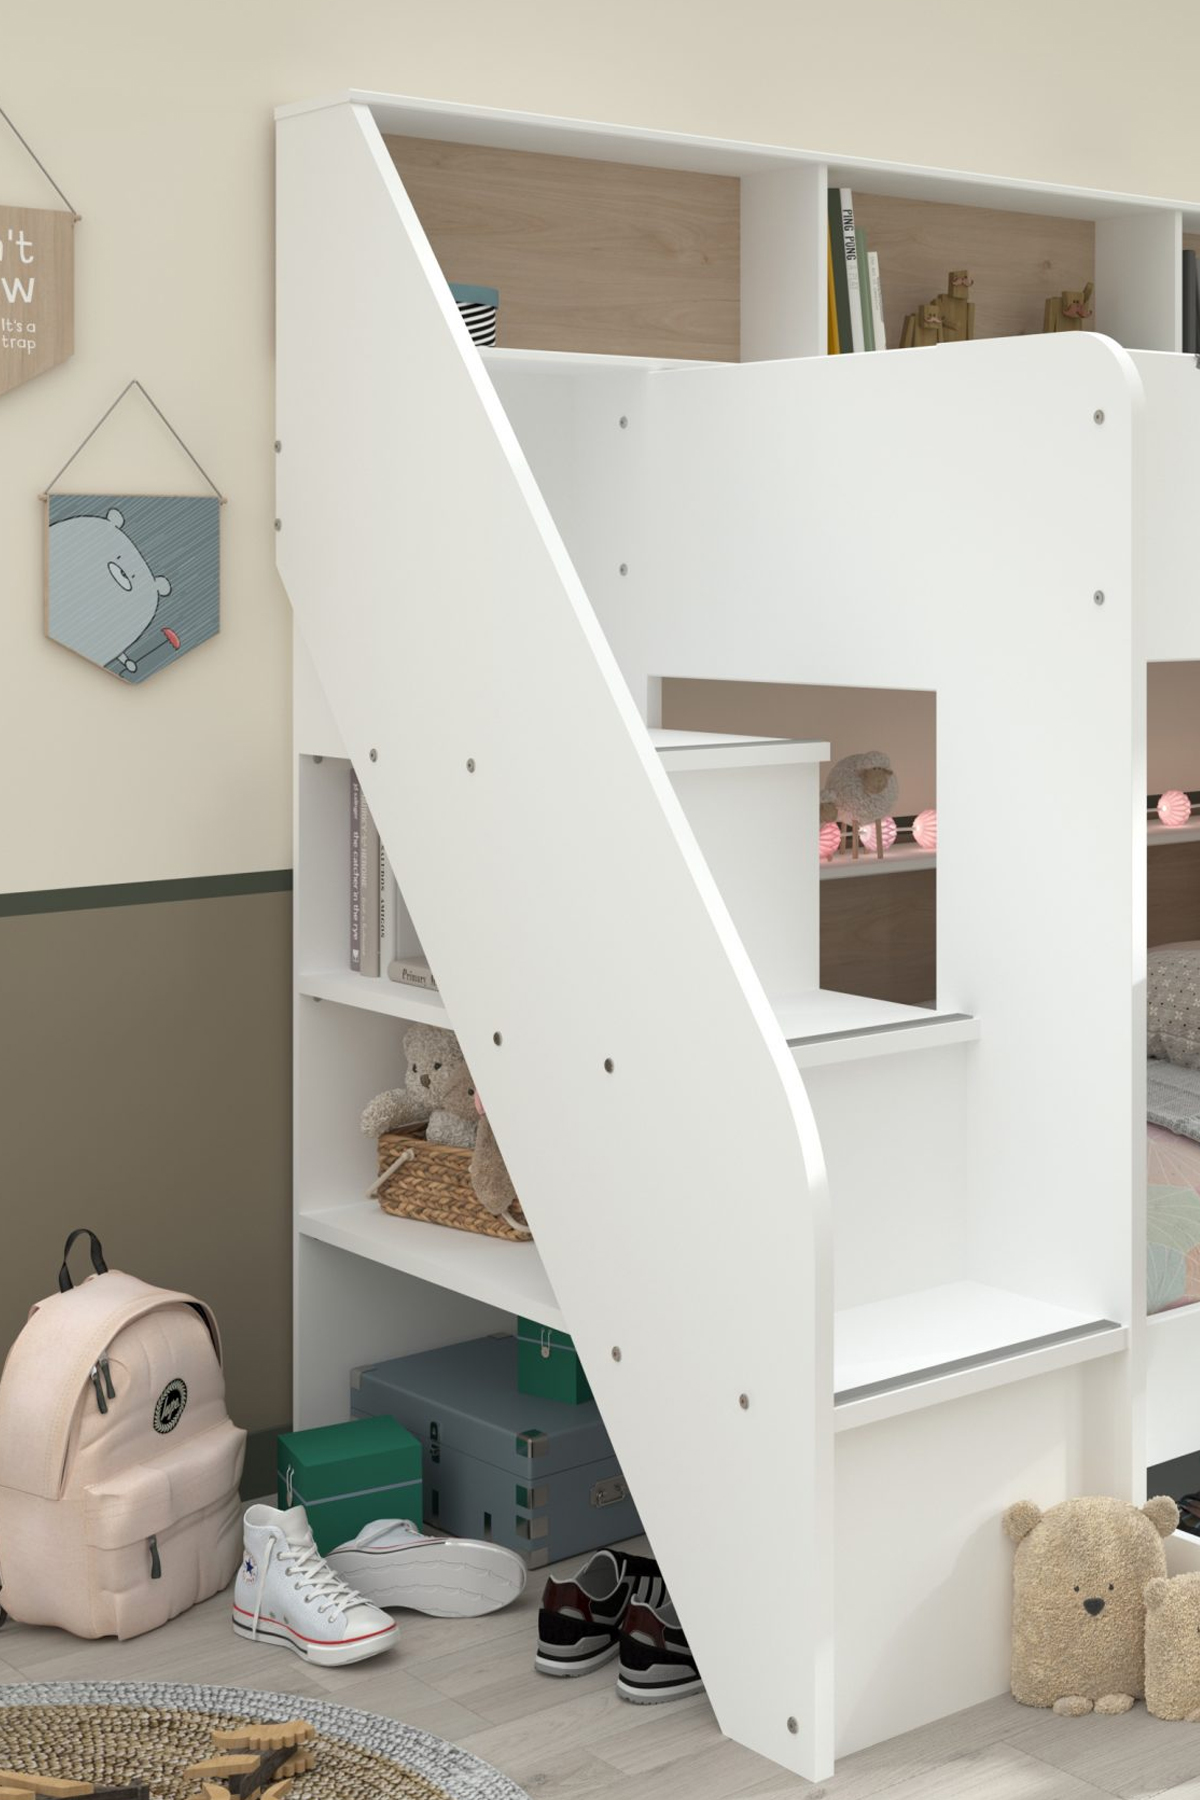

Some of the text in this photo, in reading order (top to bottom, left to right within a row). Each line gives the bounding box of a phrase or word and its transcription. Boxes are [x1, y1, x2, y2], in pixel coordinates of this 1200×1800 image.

[842, 209, 854, 232] PING
[0, 228, 35, 264] 't
[845, 235, 857, 261] PONG
[1, 317, 36, 333] It's a
[1, 335, 37, 355] trap
[351, 831, 360, 941] the catcher in the rye
